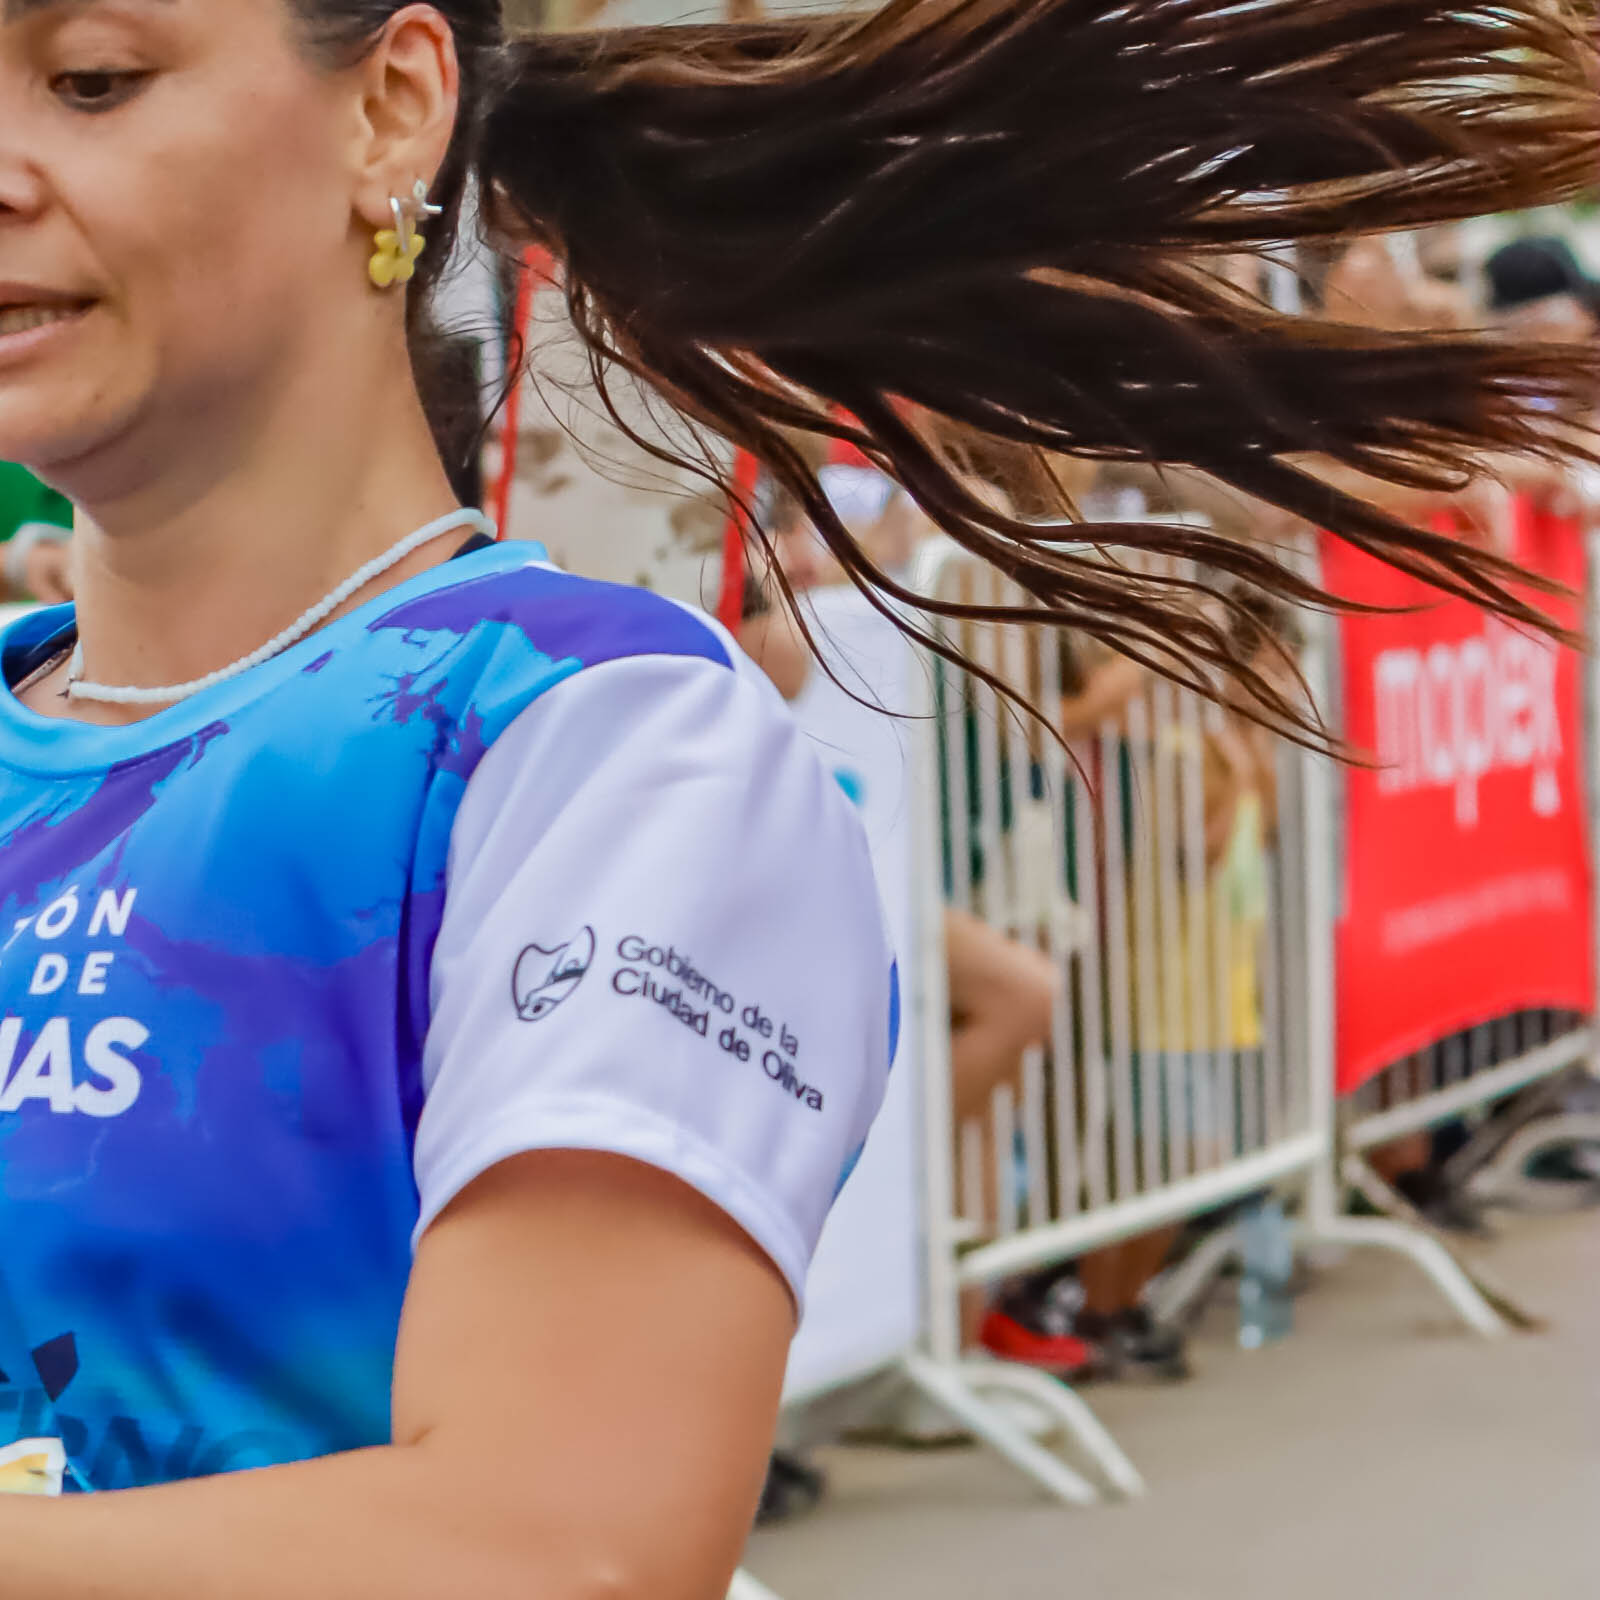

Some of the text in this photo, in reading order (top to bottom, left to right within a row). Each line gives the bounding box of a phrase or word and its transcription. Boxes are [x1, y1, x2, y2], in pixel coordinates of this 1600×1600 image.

[28, 951, 115, 996] DE
[616, 935, 800, 1057] Gobierno de la
[611, 967, 824, 1112] Ciudad de Oliva
